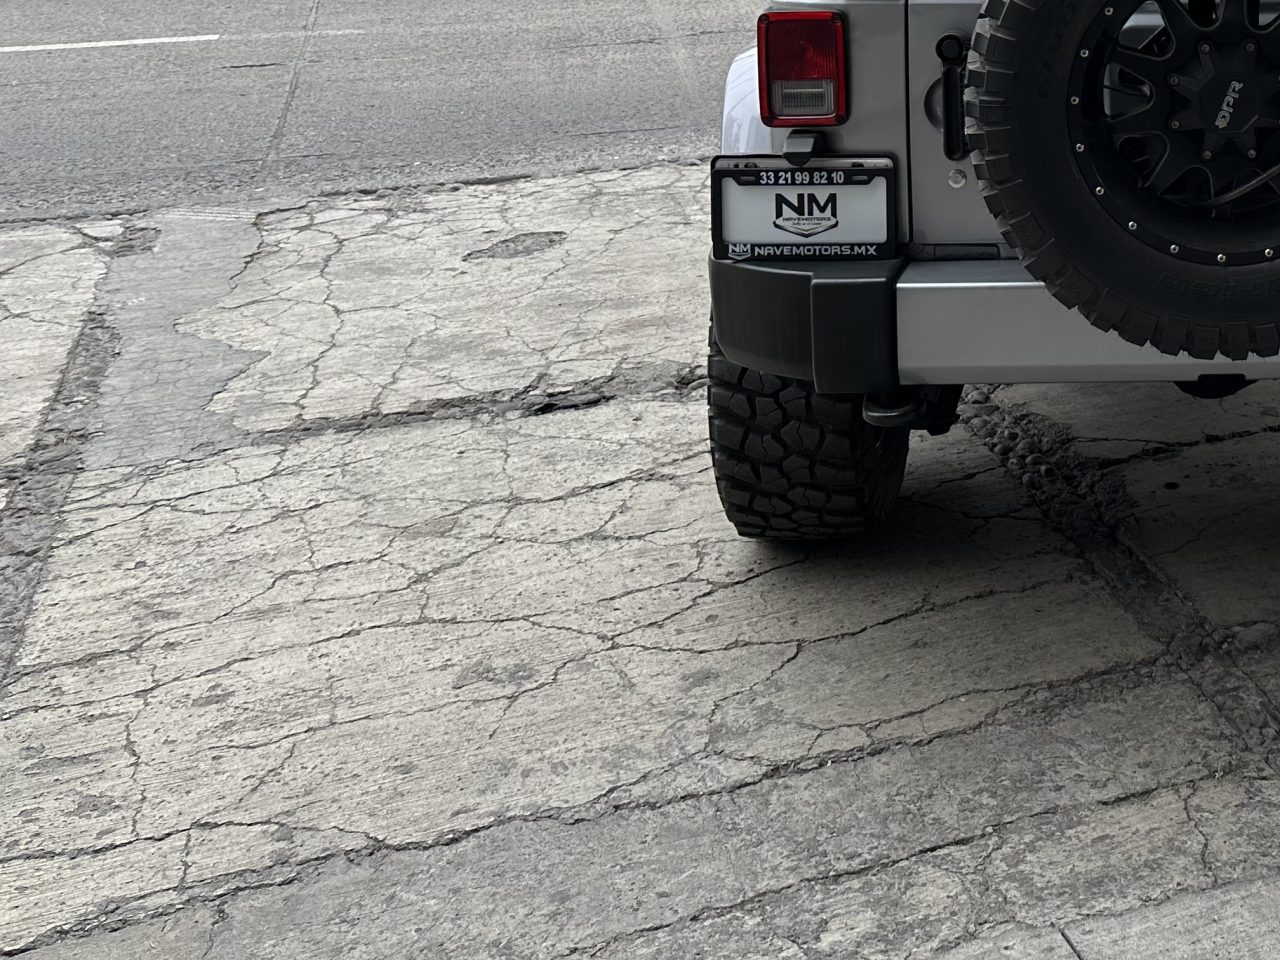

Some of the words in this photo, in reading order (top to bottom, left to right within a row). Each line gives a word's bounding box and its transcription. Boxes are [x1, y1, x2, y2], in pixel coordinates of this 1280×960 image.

[759, 171, 775, 184] 33
[778, 171, 792, 184] 21
[794, 171, 810, 184] 99
[813, 171, 828, 184] 82
[830, 171, 845, 184] 10
[775, 192, 837, 219] NM
[754, 244, 878, 256] NAVEMOTORS.MX
